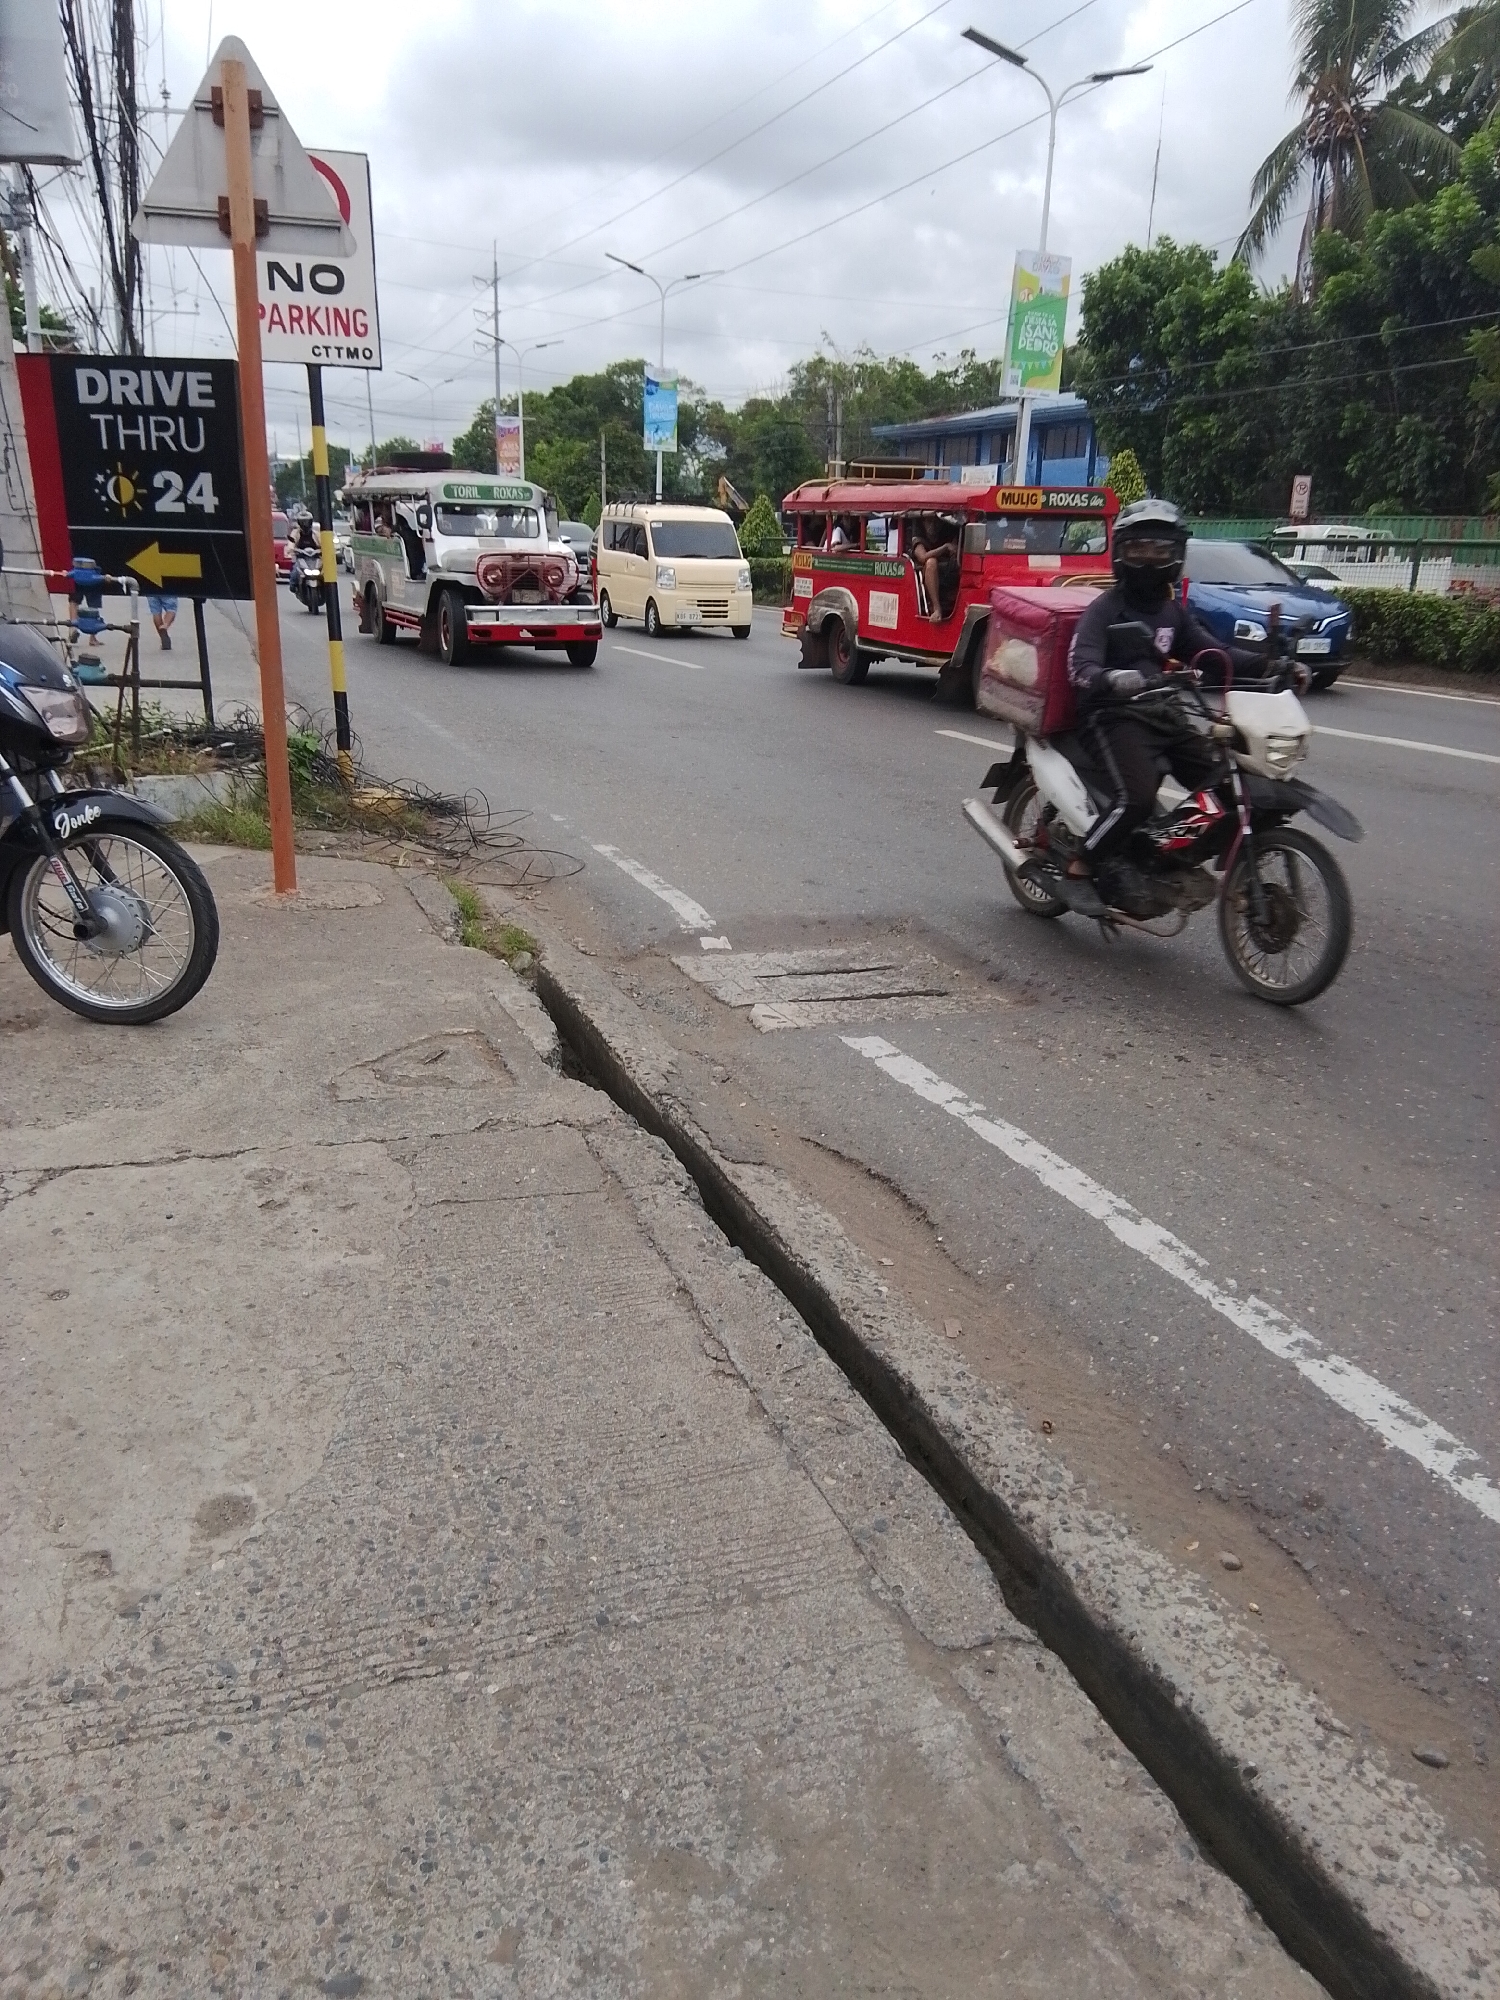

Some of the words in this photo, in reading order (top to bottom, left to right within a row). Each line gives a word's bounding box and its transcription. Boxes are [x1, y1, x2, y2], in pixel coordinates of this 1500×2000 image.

[267, 261, 345, 295] NO
[1025, 324, 1053, 341] SAN
[311, 345, 373, 360] CTTMO
[1018, 334, 1059, 357] PEDRO
[75, 368, 216, 408] DRIVE
[90, 413, 205, 453] THRU
[152, 470, 219, 514] 24
[451, 485, 481, 499] TORIL
[494, 486, 523, 500] ROXAS
[1001, 492, 1038, 508] MULIG
[1048, 493, 1089, 507] ROXAS
[874, 561, 898, 576] ROXAS
